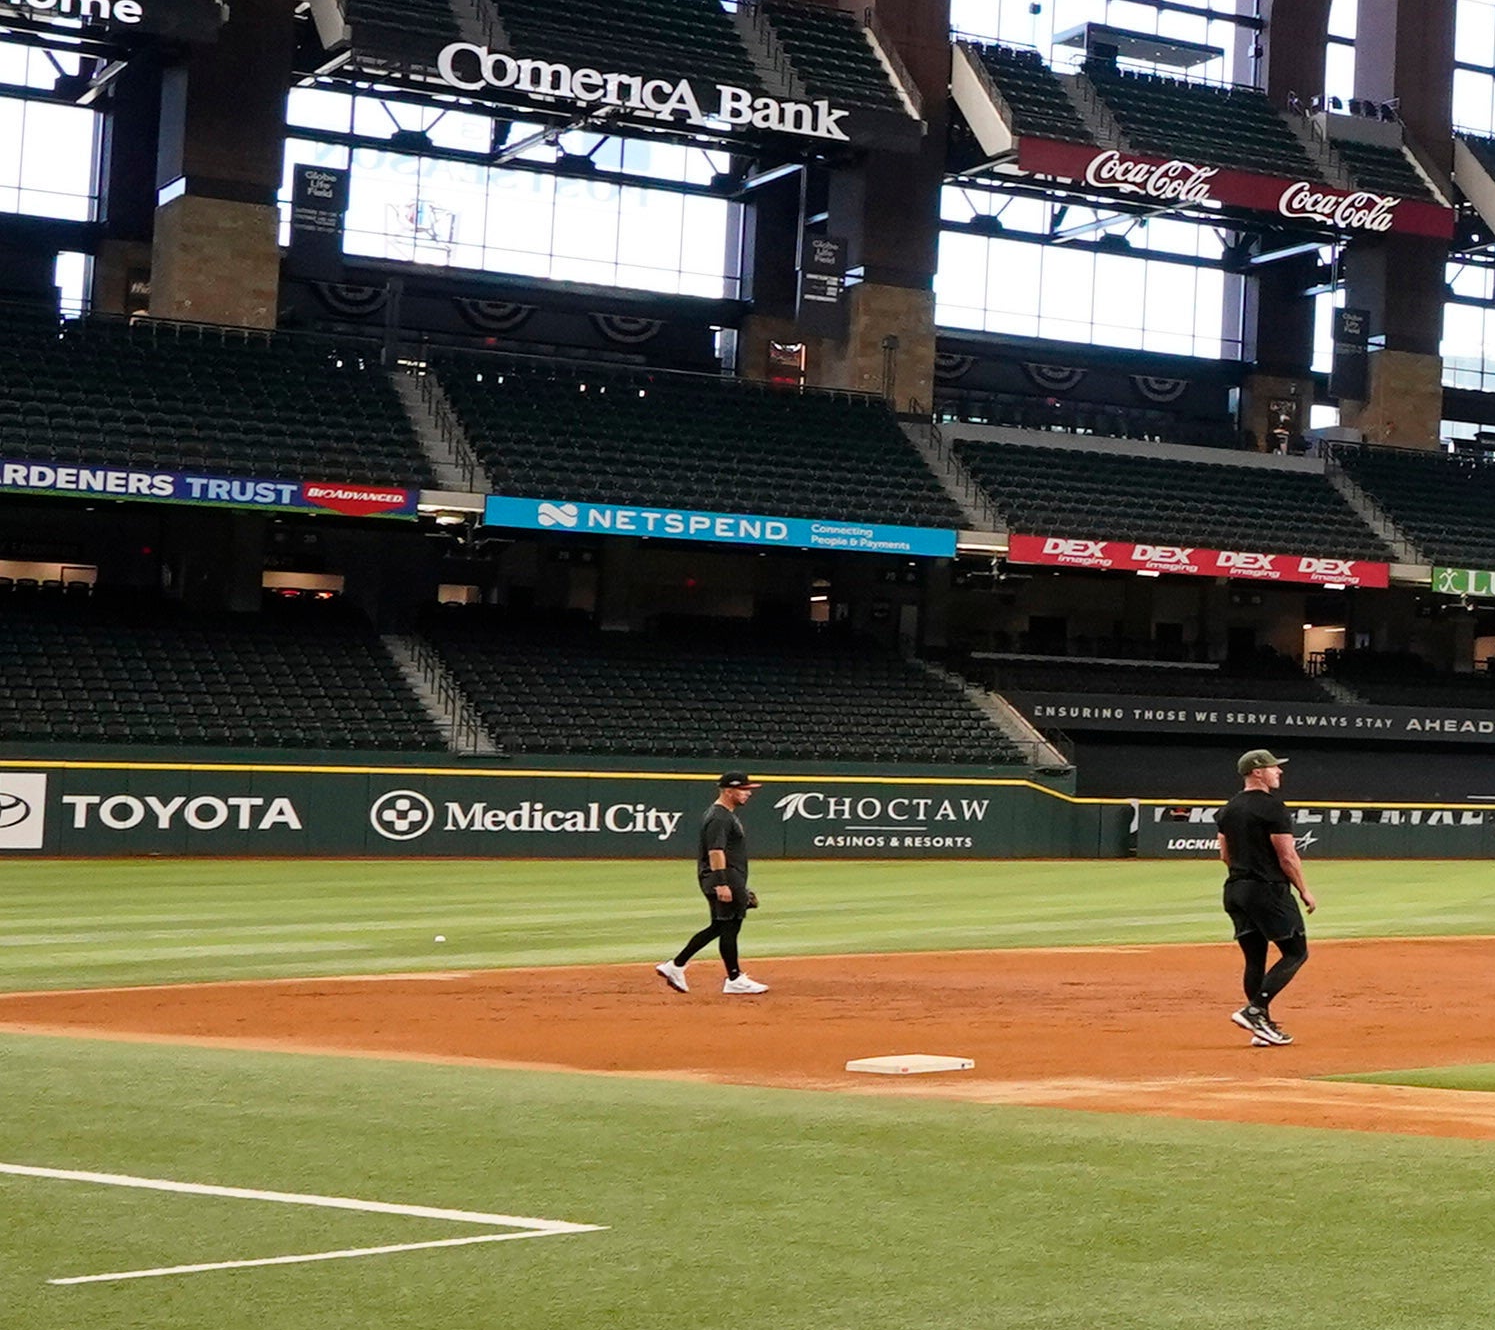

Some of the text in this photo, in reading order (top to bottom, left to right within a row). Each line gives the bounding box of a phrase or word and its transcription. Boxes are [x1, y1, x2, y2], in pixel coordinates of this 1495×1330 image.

[717, 84, 850, 141] Bank
[1086, 150, 1219, 201] Coca-Cola
[1279, 182, 1400, 232] Coca-Cola
[0, 463, 298, 505] RDENERS TRUST
[588, 508, 788, 540] NETSPEND
[811, 523, 873, 538] Connecting
[811, 534, 847, 548] People
[860, 537, 911, 552] Payments
[1042, 539, 1107, 558] DEX
[1131, 544, 1194, 564] DEX
[1216, 551, 1276, 570] DEX
[1299, 557, 1356, 576] DEX
[1034, 706, 1124, 719] ENSURING
[1134, 709, 1186, 721] THOSE
[1195, 711, 1218, 722] WE
[1226, 713, 1277, 724] SERVE
[1285, 715, 1347, 727] ALWAYS
[1355, 717, 1393, 728] STAY
[1406, 718, 1494, 733] AHEAD
[62, 795, 302, 831] TOYOTA
[444, 800, 682, 841] Medical City
[797, 792, 989, 821] CHOCTAW
[814, 836, 972, 848] CASINOS & RESORTS
